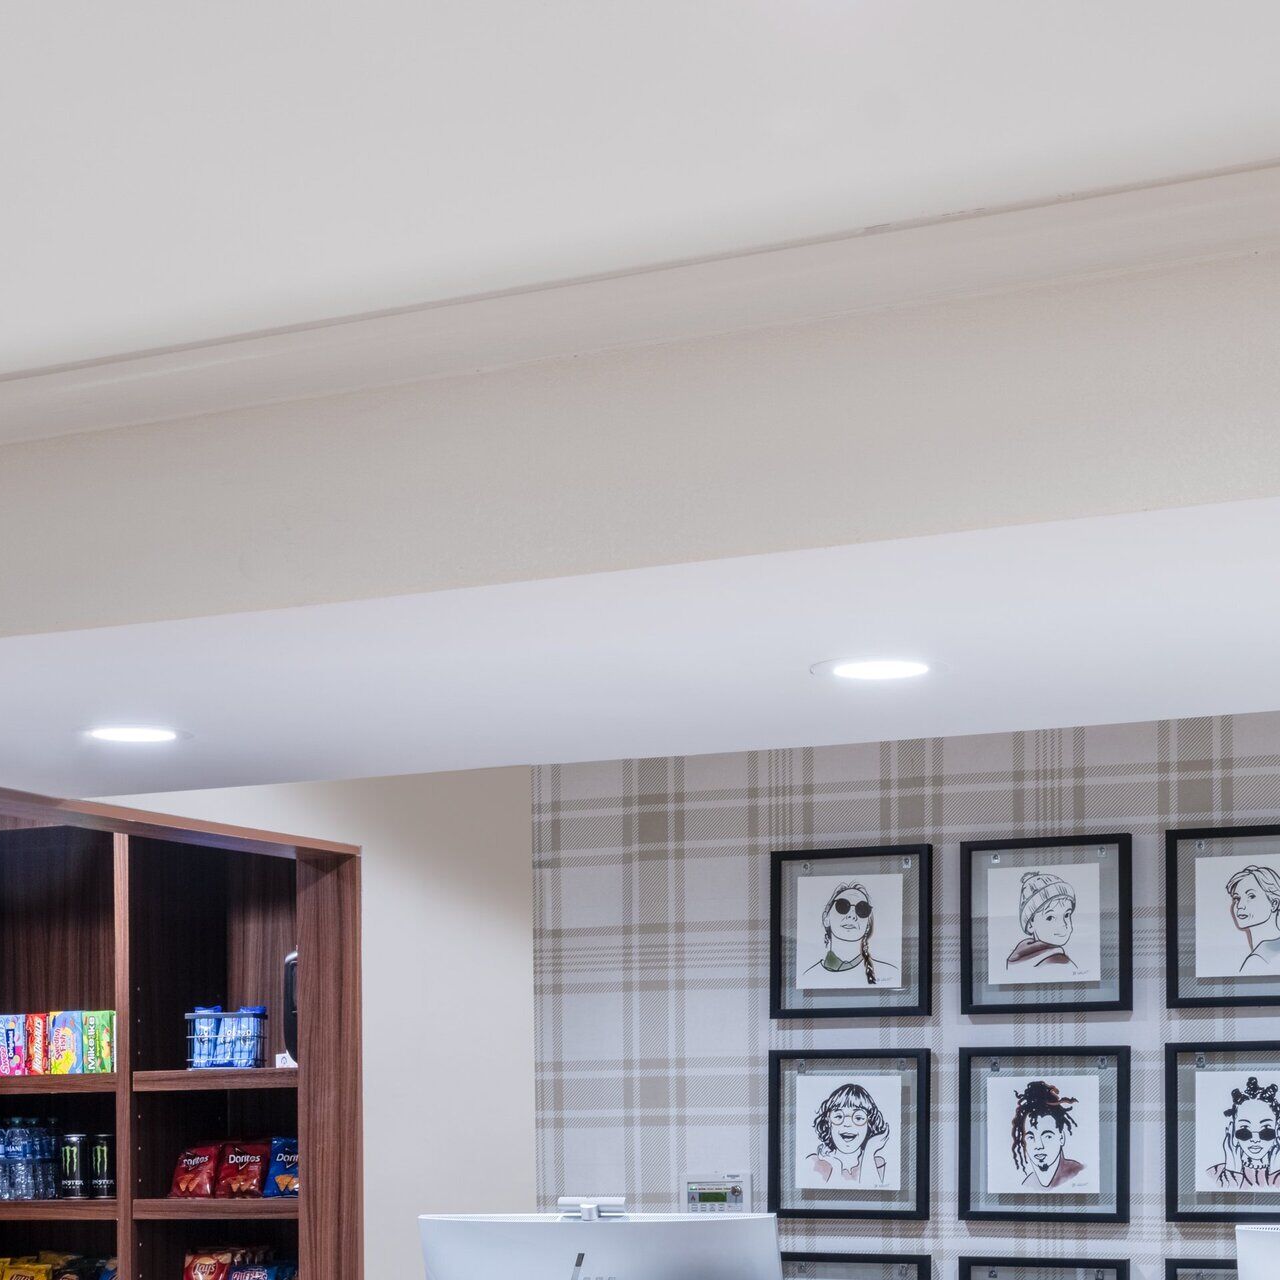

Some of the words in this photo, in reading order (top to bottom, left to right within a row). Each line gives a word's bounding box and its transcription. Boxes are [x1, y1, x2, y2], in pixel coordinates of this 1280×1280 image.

[87, 1016, 96, 1035] Ike
[87, 1039, 96, 1070] Mike
[228, 1154, 261, 1164] Doritos
